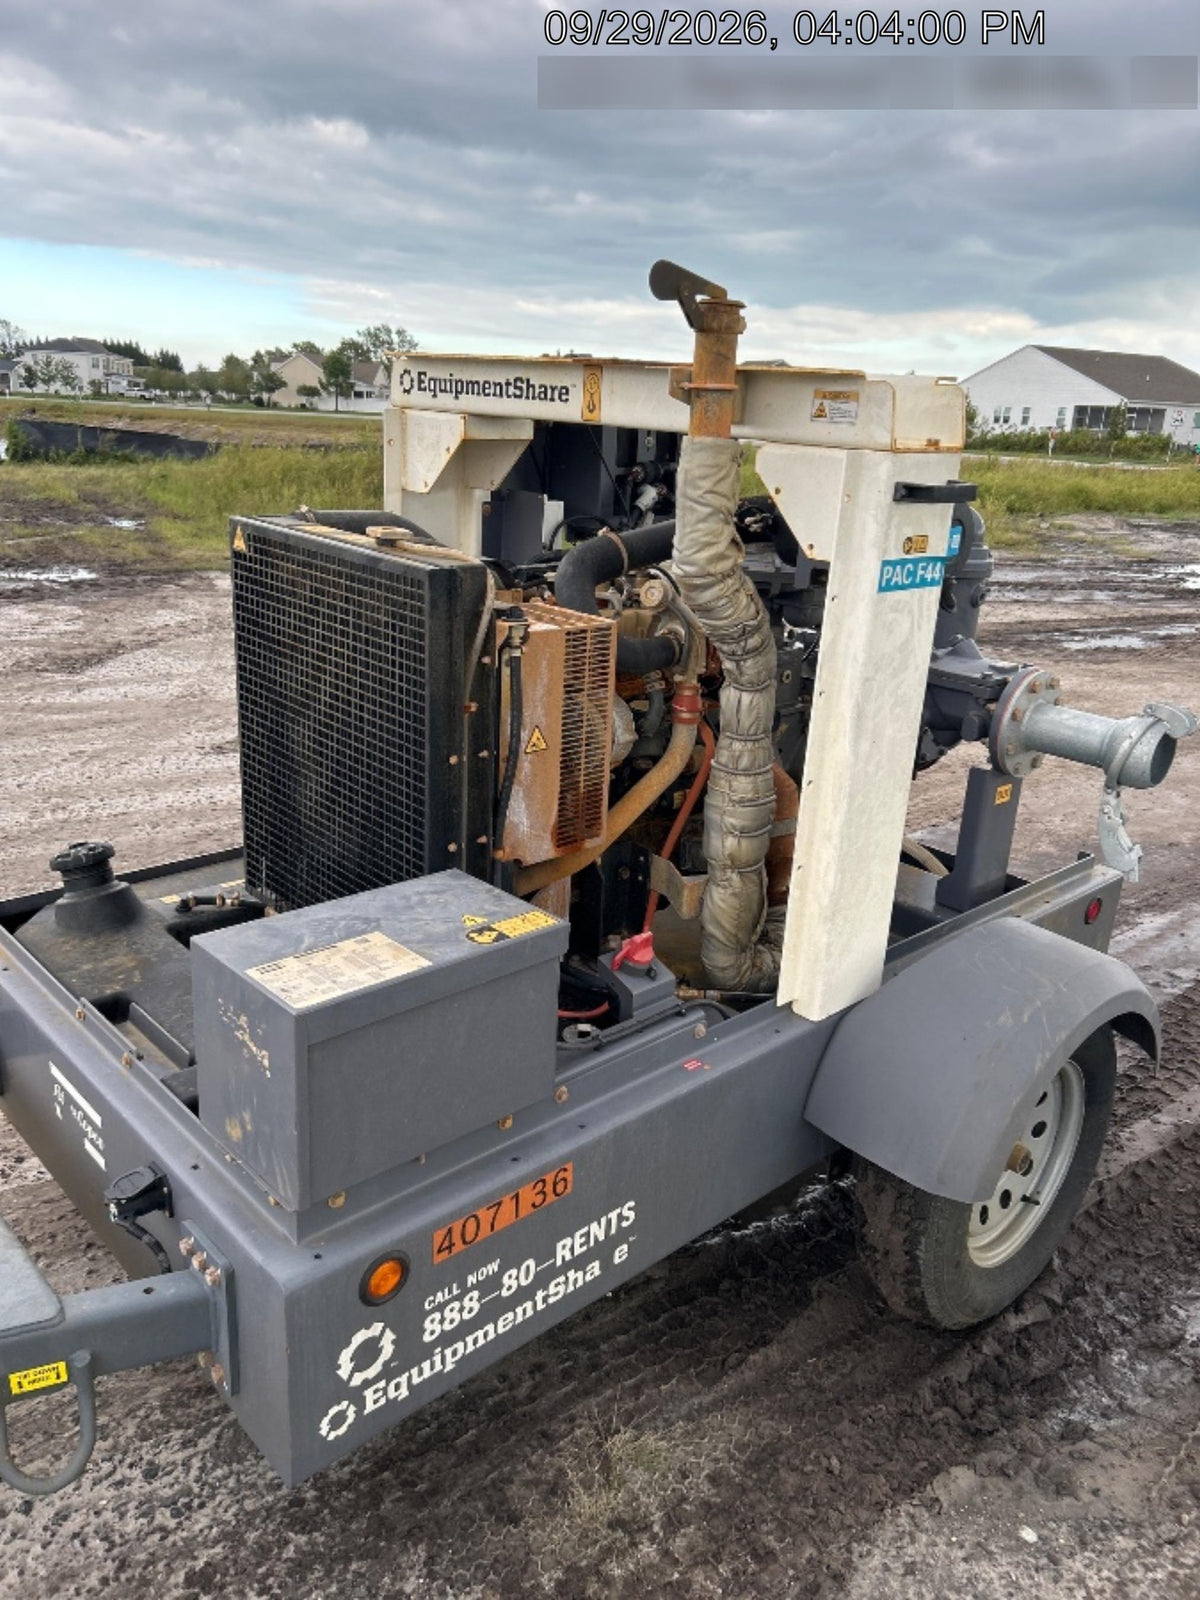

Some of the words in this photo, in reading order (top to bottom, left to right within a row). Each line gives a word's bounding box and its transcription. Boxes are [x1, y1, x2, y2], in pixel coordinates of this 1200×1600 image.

[417, 371, 570, 402] EquipmentShare
[882, 564, 914, 587] PAC
[436, 1167, 569, 1256] 407136
[424, 1283, 461, 1311] CALL
[466, 1258, 501, 1288] NOW
